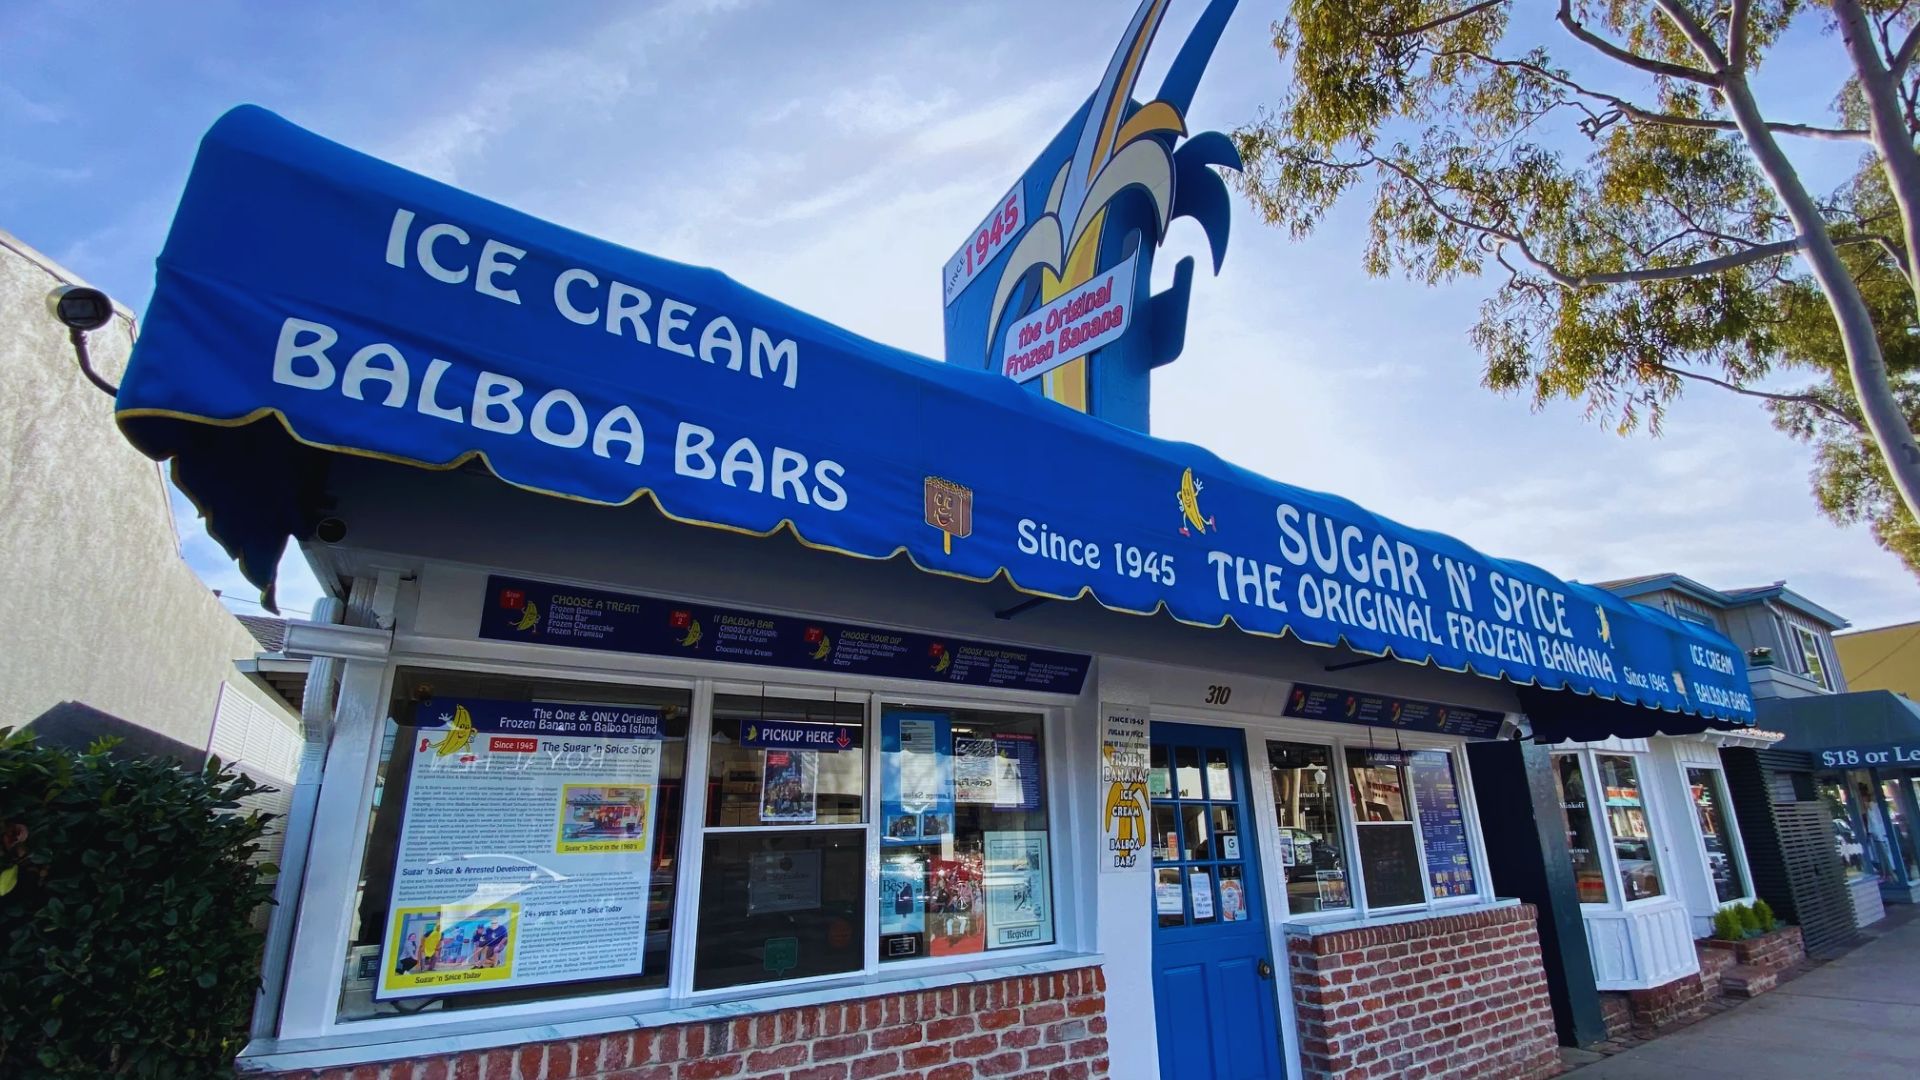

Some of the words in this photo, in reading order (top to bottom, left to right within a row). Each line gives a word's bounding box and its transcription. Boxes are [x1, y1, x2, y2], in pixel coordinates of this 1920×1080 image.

[946, 257, 965, 294] SINCE
[965, 194, 1019, 277] 1945
[385, 207, 527, 305] ICE
[553, 267, 798, 389] CREAM
[1018, 319, 1043, 350] the
[1045, 275, 1114, 336] Original
[1005, 340, 1055, 378] Frozen
[1058, 304, 1124, 355] Banana
[272, 317, 646, 467] BALBOA
[674, 421, 849, 512] BARS
[1017, 517, 1101, 570] Since
[1113, 542, 1176, 587] 1945
[1277, 503, 1427, 598] SUGAR
[1489, 572, 1572, 638] SPICE
[551, 594, 595, 609] CHOOSE
[595, 599, 603, 609] A
[550, 604, 575, 615] Frozen
[576, 607, 602, 618] Banana
[1207, 550, 1287, 613] THE
[1297, 571, 1444, 647] ORIGINAL
[1444, 608, 1533, 666] FROZEN
[1537, 635, 1618, 687] BANANA
[547, 626, 572, 637] Frozen
[548, 618, 573, 629] Frozen
[1689, 643, 1707, 668] ICE
[1705, 649, 1736, 676] CREAM
[1623, 665, 1648, 689] Since
[1650, 672, 1670, 694] 1945
[1204, 685, 1231, 705] 310
[1693, 682, 1729, 707] BALBOA
[1728, 690, 1752, 713] BARS
[532, 708, 555, 719] The
[555, 709, 576, 721] One
[579, 713, 589, 721] &
[591, 712, 619, 723] ONLY
[621, 713, 658, 726] Original
[1108, 716, 1129, 724] SINCE
[1129, 716, 1145, 726] 1945
[499, 717, 538, 730] Frozen
[539, 718, 576, 731] Banana
[579, 723, 592, 732] on
[593, 721, 628, 734] Balboa
[629, 722, 657, 735] Island
[762, 728, 804, 742] PICKUP
[805, 730, 834, 744] HERE
[494, 740, 514, 750] Since
[515, 740, 534, 750] 1945
[542, 742, 560, 753] The
[562, 743, 591, 755] Sugar
[605, 743, 630, 755] Spice
[631, 745, 656, 756] Story
[1110, 751, 1145, 769] FROZEN
[1822, 750, 1859, 767] $18
[1865, 751, 1888, 764] or
[1104, 766, 1150, 784] BANANAS
[1120, 789, 1133, 801] ICE
[1112, 805, 1140, 817] CREAM
[1109, 838, 1141, 851] BALBOA
[1228, 838, 1235, 849] G
[1114, 855, 1137, 868] BARS
[402, 868, 424, 877] Sugar
[434, 867, 455, 876] Spice
[455, 866, 463, 875] &
[464, 866, 495, 875] Arrested
[495, 865, 538, 876] Development
[559, 907, 578, 916] Sugar
[587, 906, 604, 915] Spice
[604, 905, 623, 914] Today
[1006, 929, 1034, 941] Register
[415, 975, 435, 984] Sugar
[444, 972, 462, 982] Spice
[463, 970, 482, 981] Today
